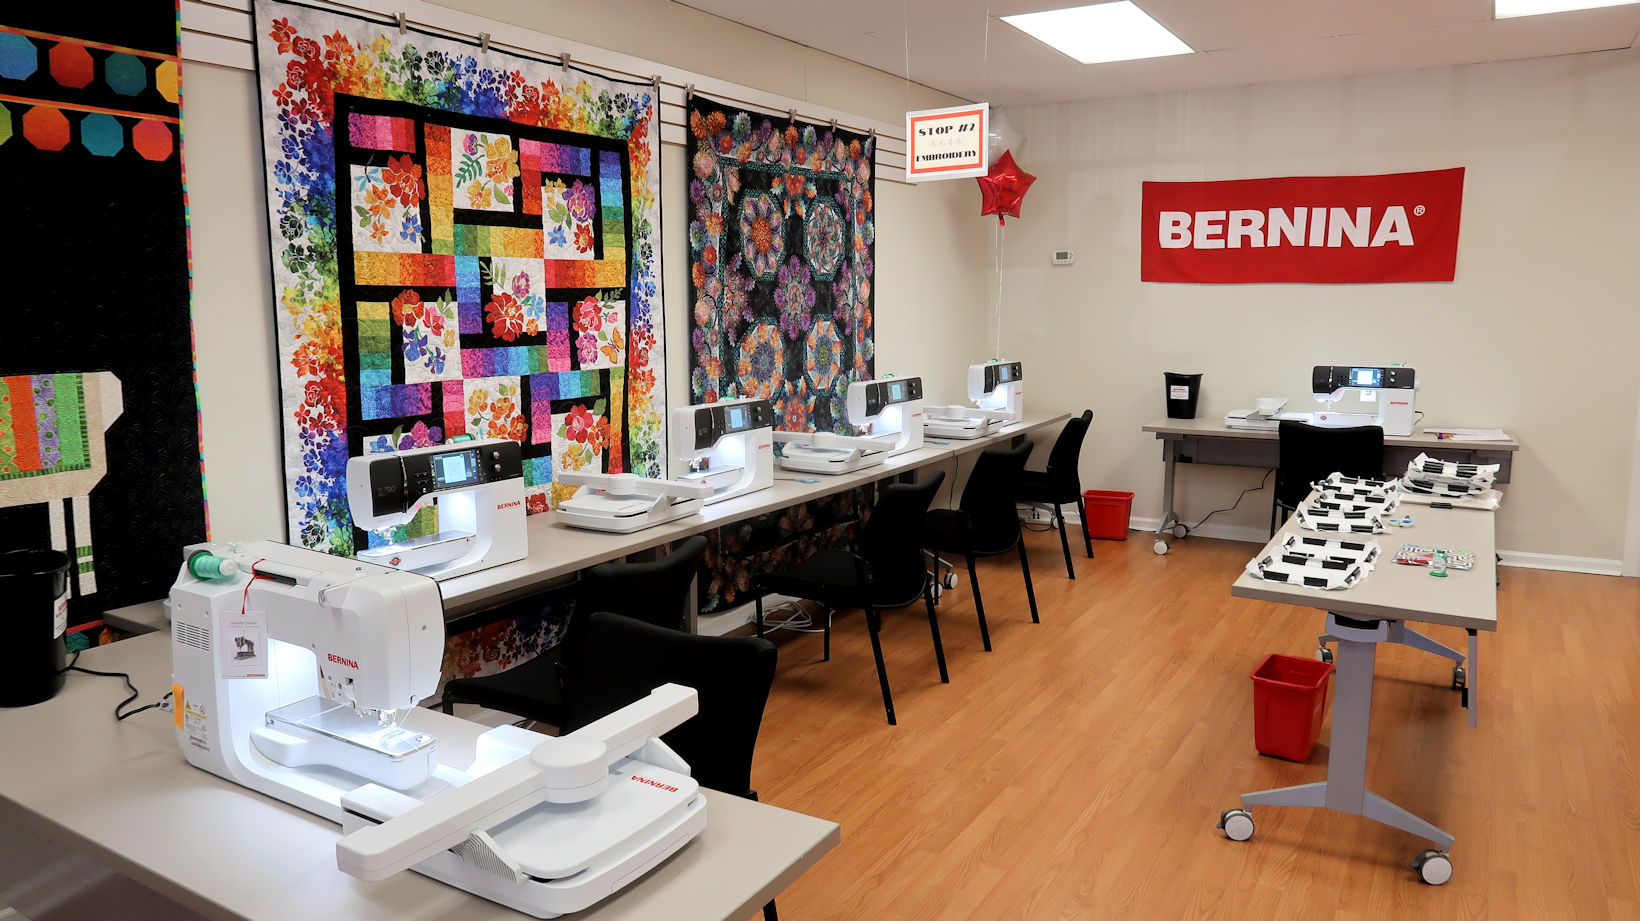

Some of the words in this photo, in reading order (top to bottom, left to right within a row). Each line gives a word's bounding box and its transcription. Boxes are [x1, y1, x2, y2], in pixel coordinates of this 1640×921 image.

[918, 126, 953, 136] STOP
[958, 123, 975, 133] #2
[916, 150, 976, 162] EMBROIDERY
[497, 500, 521, 510] BERNINA
[328, 653, 359, 669] BERNINA
[631, 775, 679, 793] BERNINA
